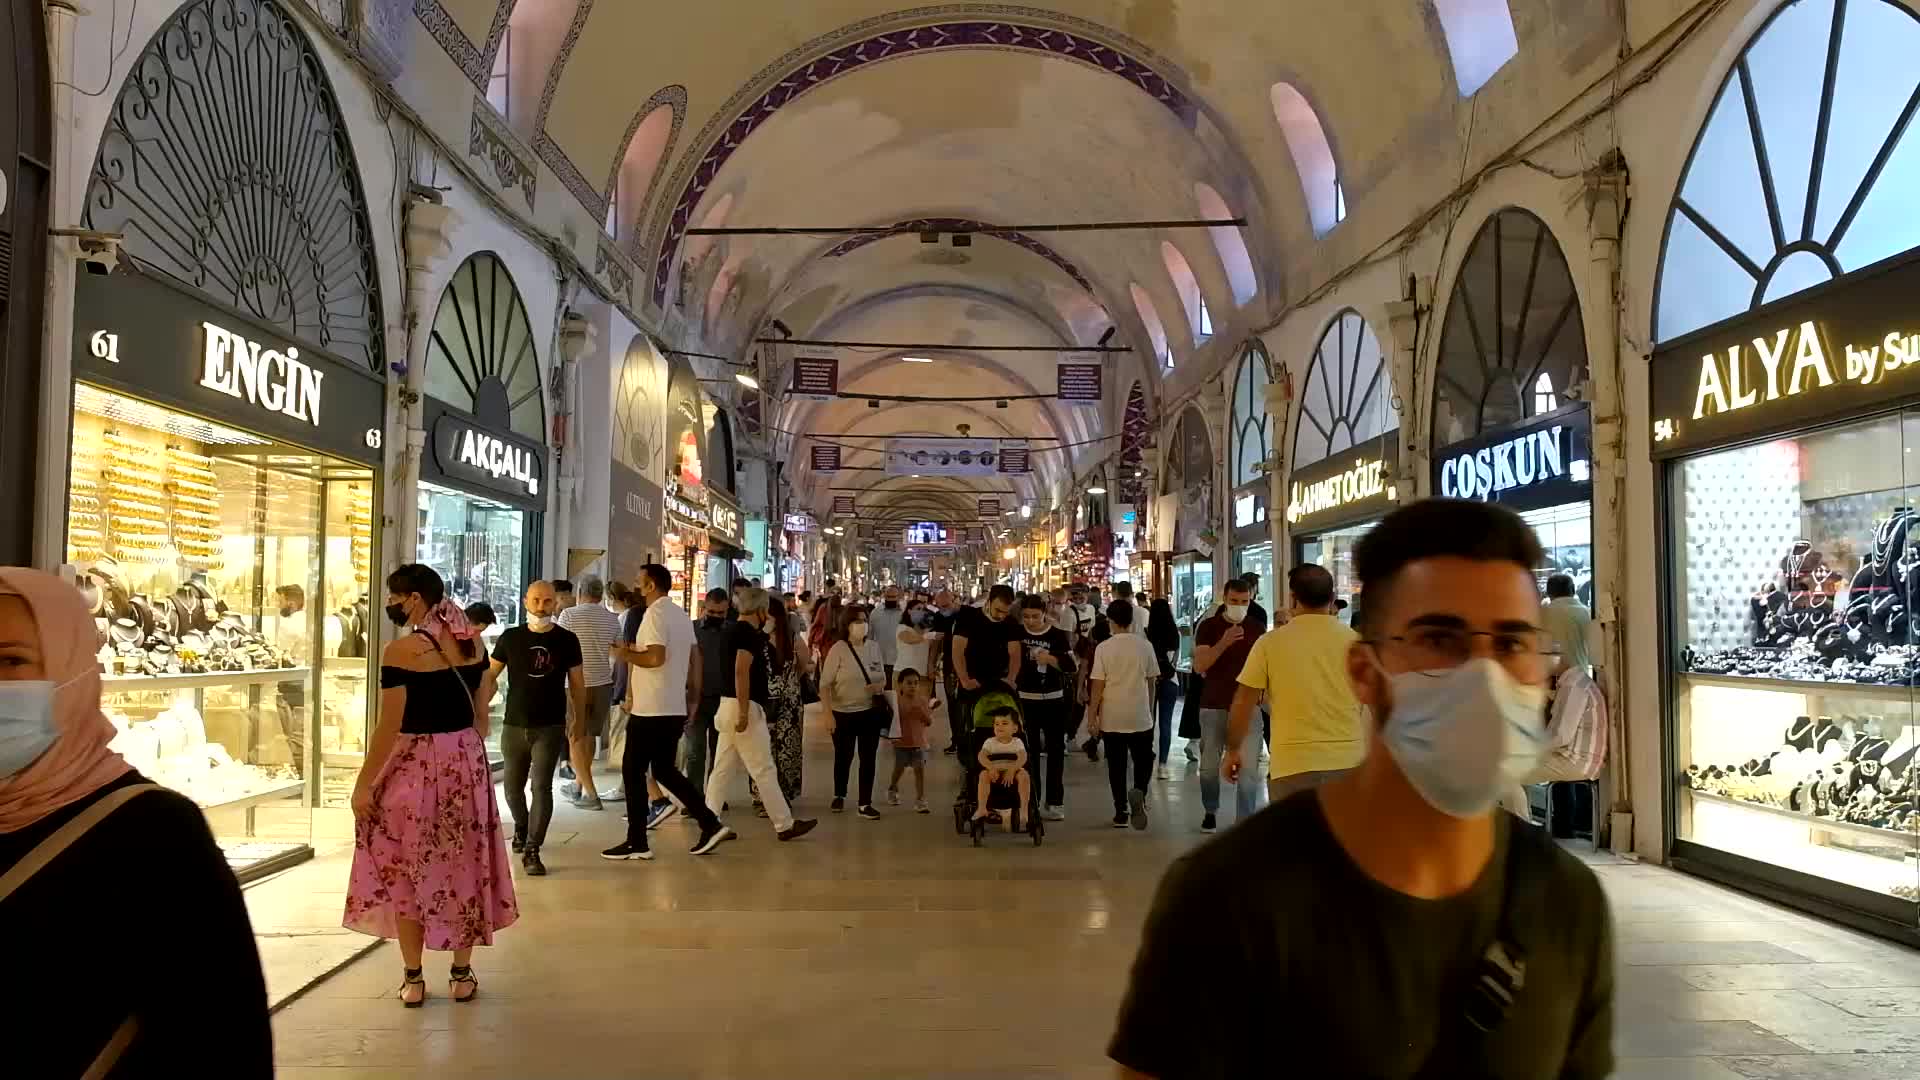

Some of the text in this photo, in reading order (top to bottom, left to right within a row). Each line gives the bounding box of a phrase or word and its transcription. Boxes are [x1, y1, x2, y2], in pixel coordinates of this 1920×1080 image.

[91, 329, 119, 363] 61
[199, 321, 324, 426] ENGİN
[1692, 320, 1833, 420] ALYA
[1845, 343, 1880, 385] by
[365, 428, 382, 449] 63
[461, 429, 531, 483] AKÇALI
[1441, 425, 1562, 502] COŞKUN
